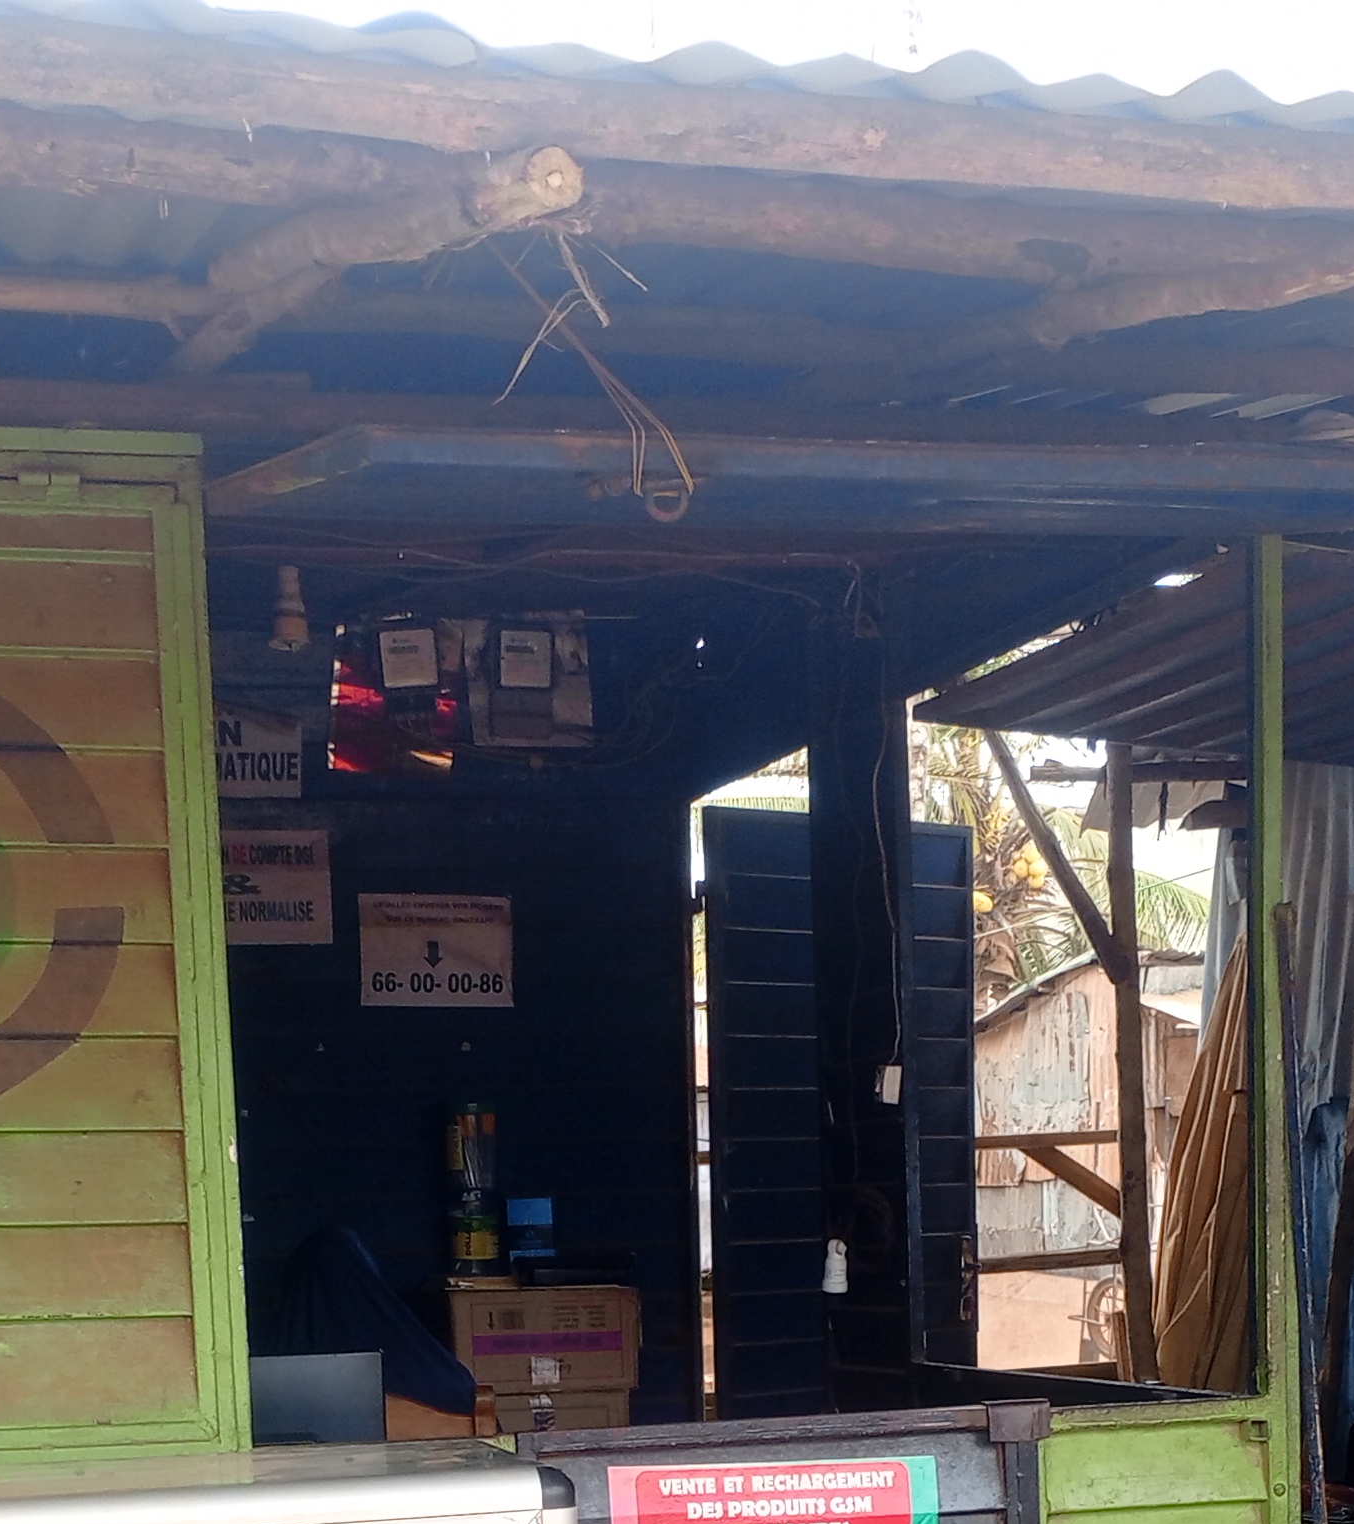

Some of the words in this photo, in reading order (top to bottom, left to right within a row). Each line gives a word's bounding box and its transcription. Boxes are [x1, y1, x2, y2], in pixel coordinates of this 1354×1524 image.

[216, 751, 299, 784] ATIQUE
[249, 845, 293, 865] COMPTE
[239, 901, 314, 922] NORMALISE
[659, 1477, 716, 1497] VENTE
[724, 1476, 744, 1494] ET
[752, 1470, 895, 1492] RECHARGEMENT
[686, 1501, 724, 1521] DES
[728, 1498, 827, 1519] PRODUITS
[830, 1496, 872, 1515] GSM
